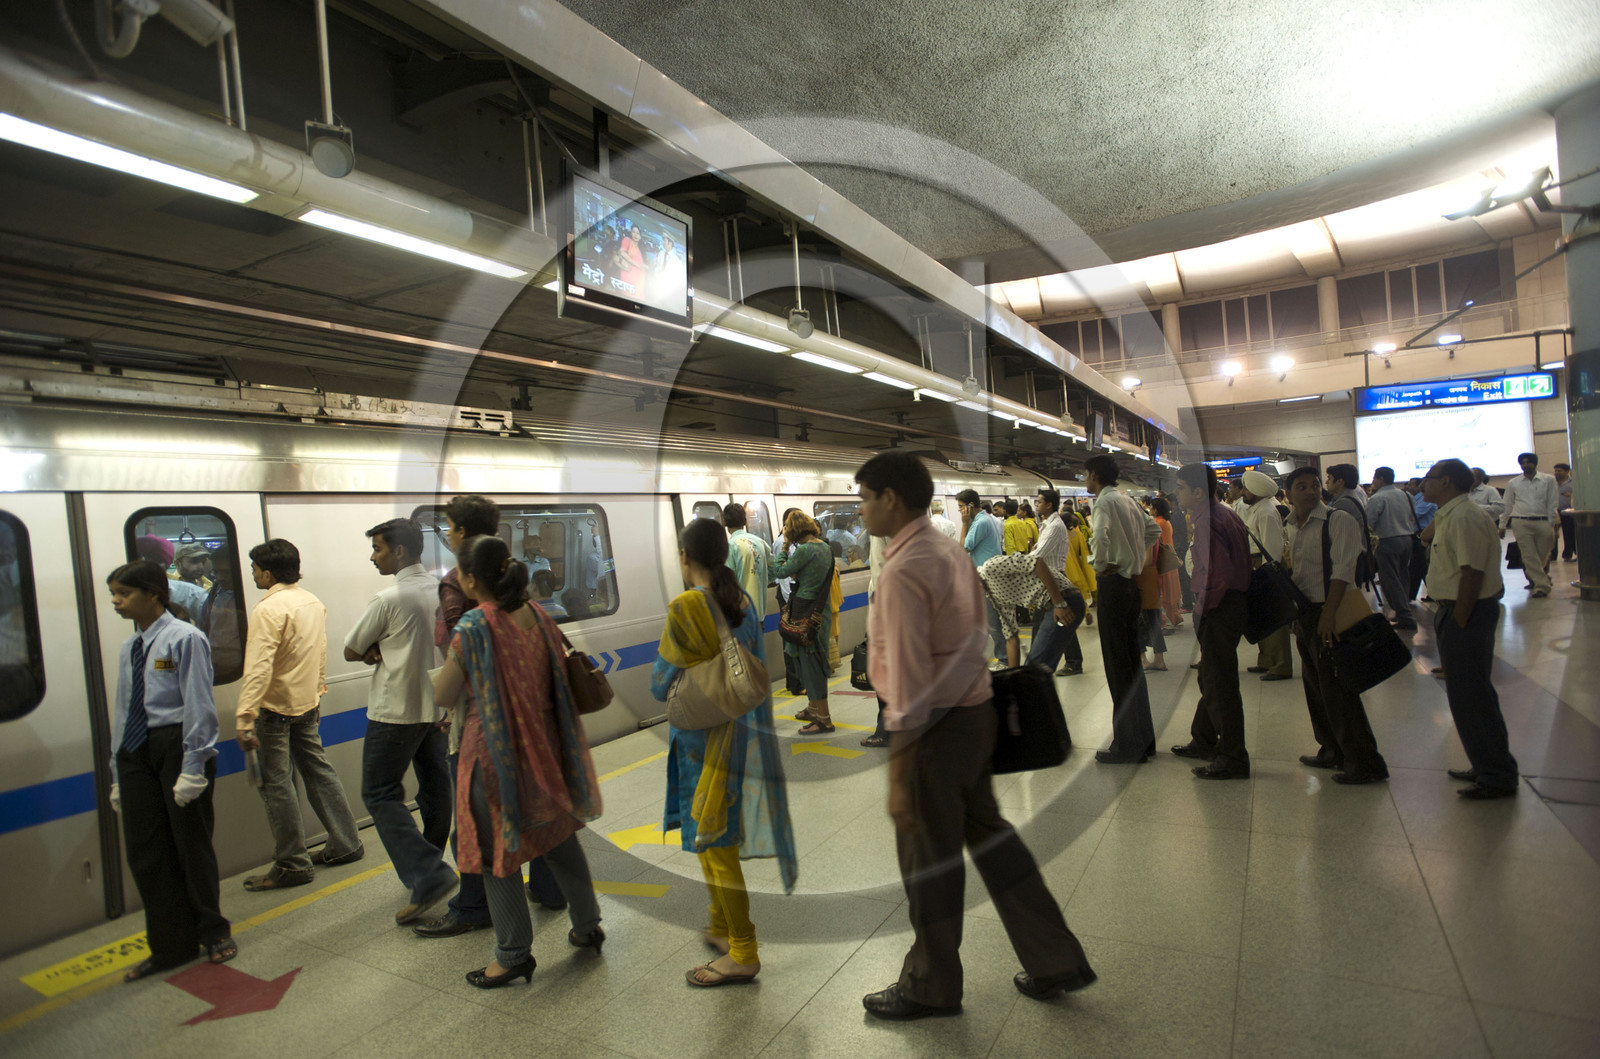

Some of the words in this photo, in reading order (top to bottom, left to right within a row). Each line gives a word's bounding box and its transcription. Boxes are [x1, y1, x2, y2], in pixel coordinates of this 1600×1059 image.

[581, 262, 605, 285] मेट्रो
[1470, 380, 1501, 391] निकास
[1483, 391, 1503, 401] Exit
